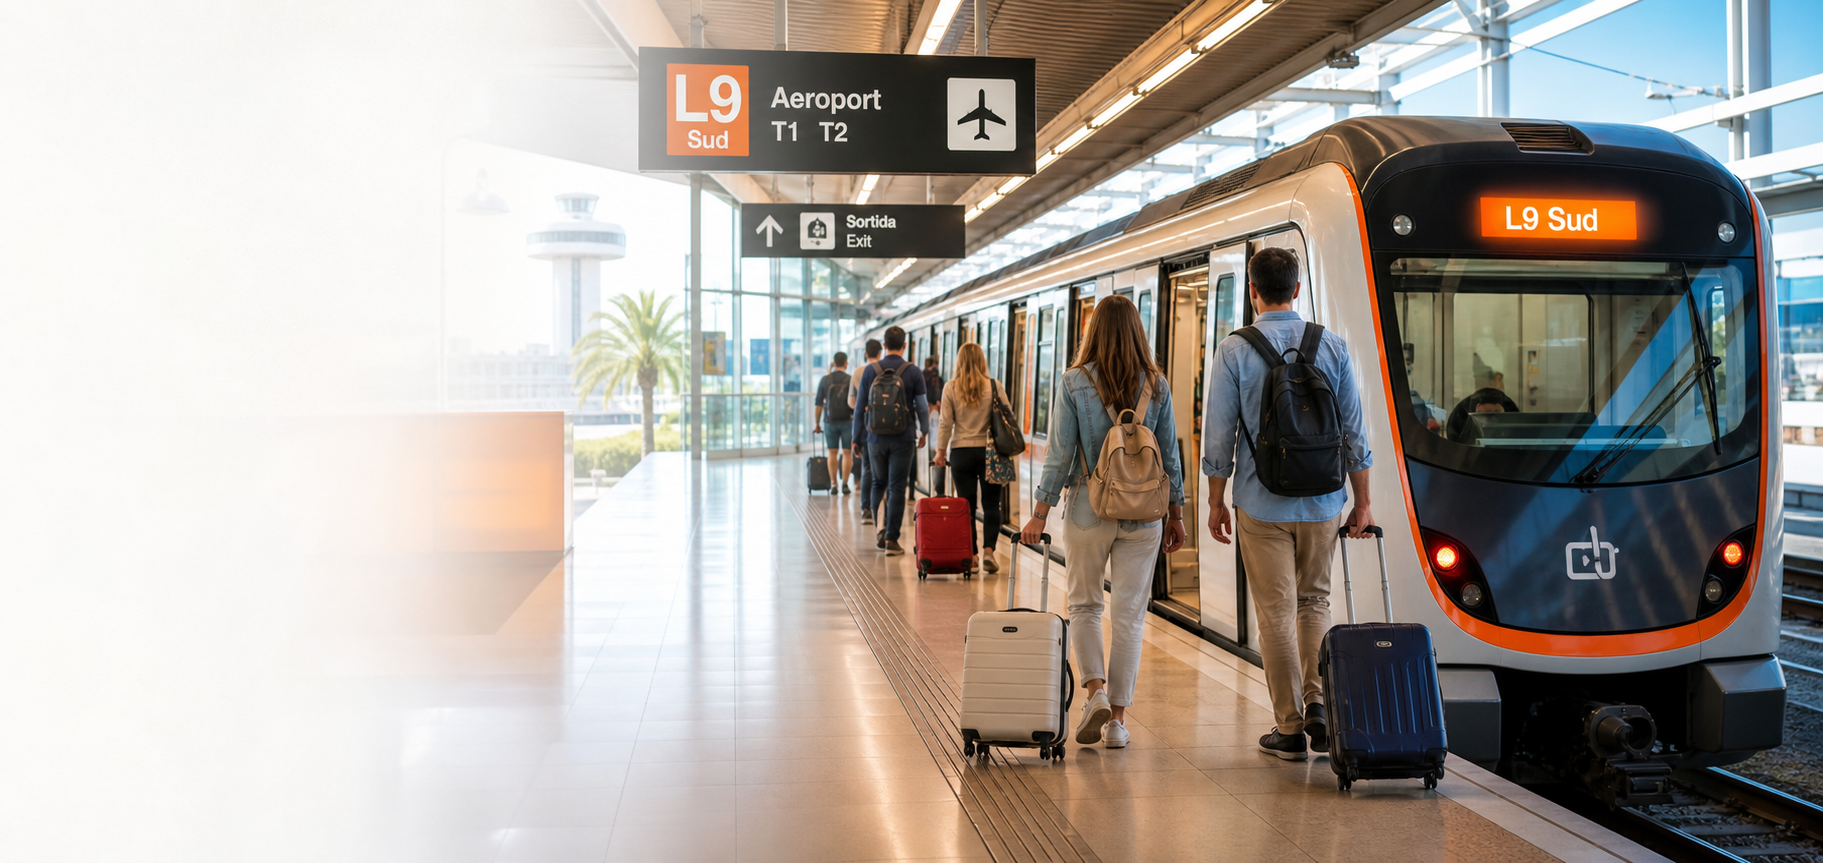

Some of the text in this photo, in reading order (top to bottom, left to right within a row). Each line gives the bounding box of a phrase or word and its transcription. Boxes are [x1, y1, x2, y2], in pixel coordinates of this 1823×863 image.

[675, 73, 742, 124] L9
[770, 86, 882, 115] Aeroport
[686, 128, 729, 150] Sud
[770, 120, 848, 143] T1 T2
[846, 214, 897, 229] Sortida
[1505, 205, 1598, 232] L9 Sud
[846, 233, 873, 248] Exit
